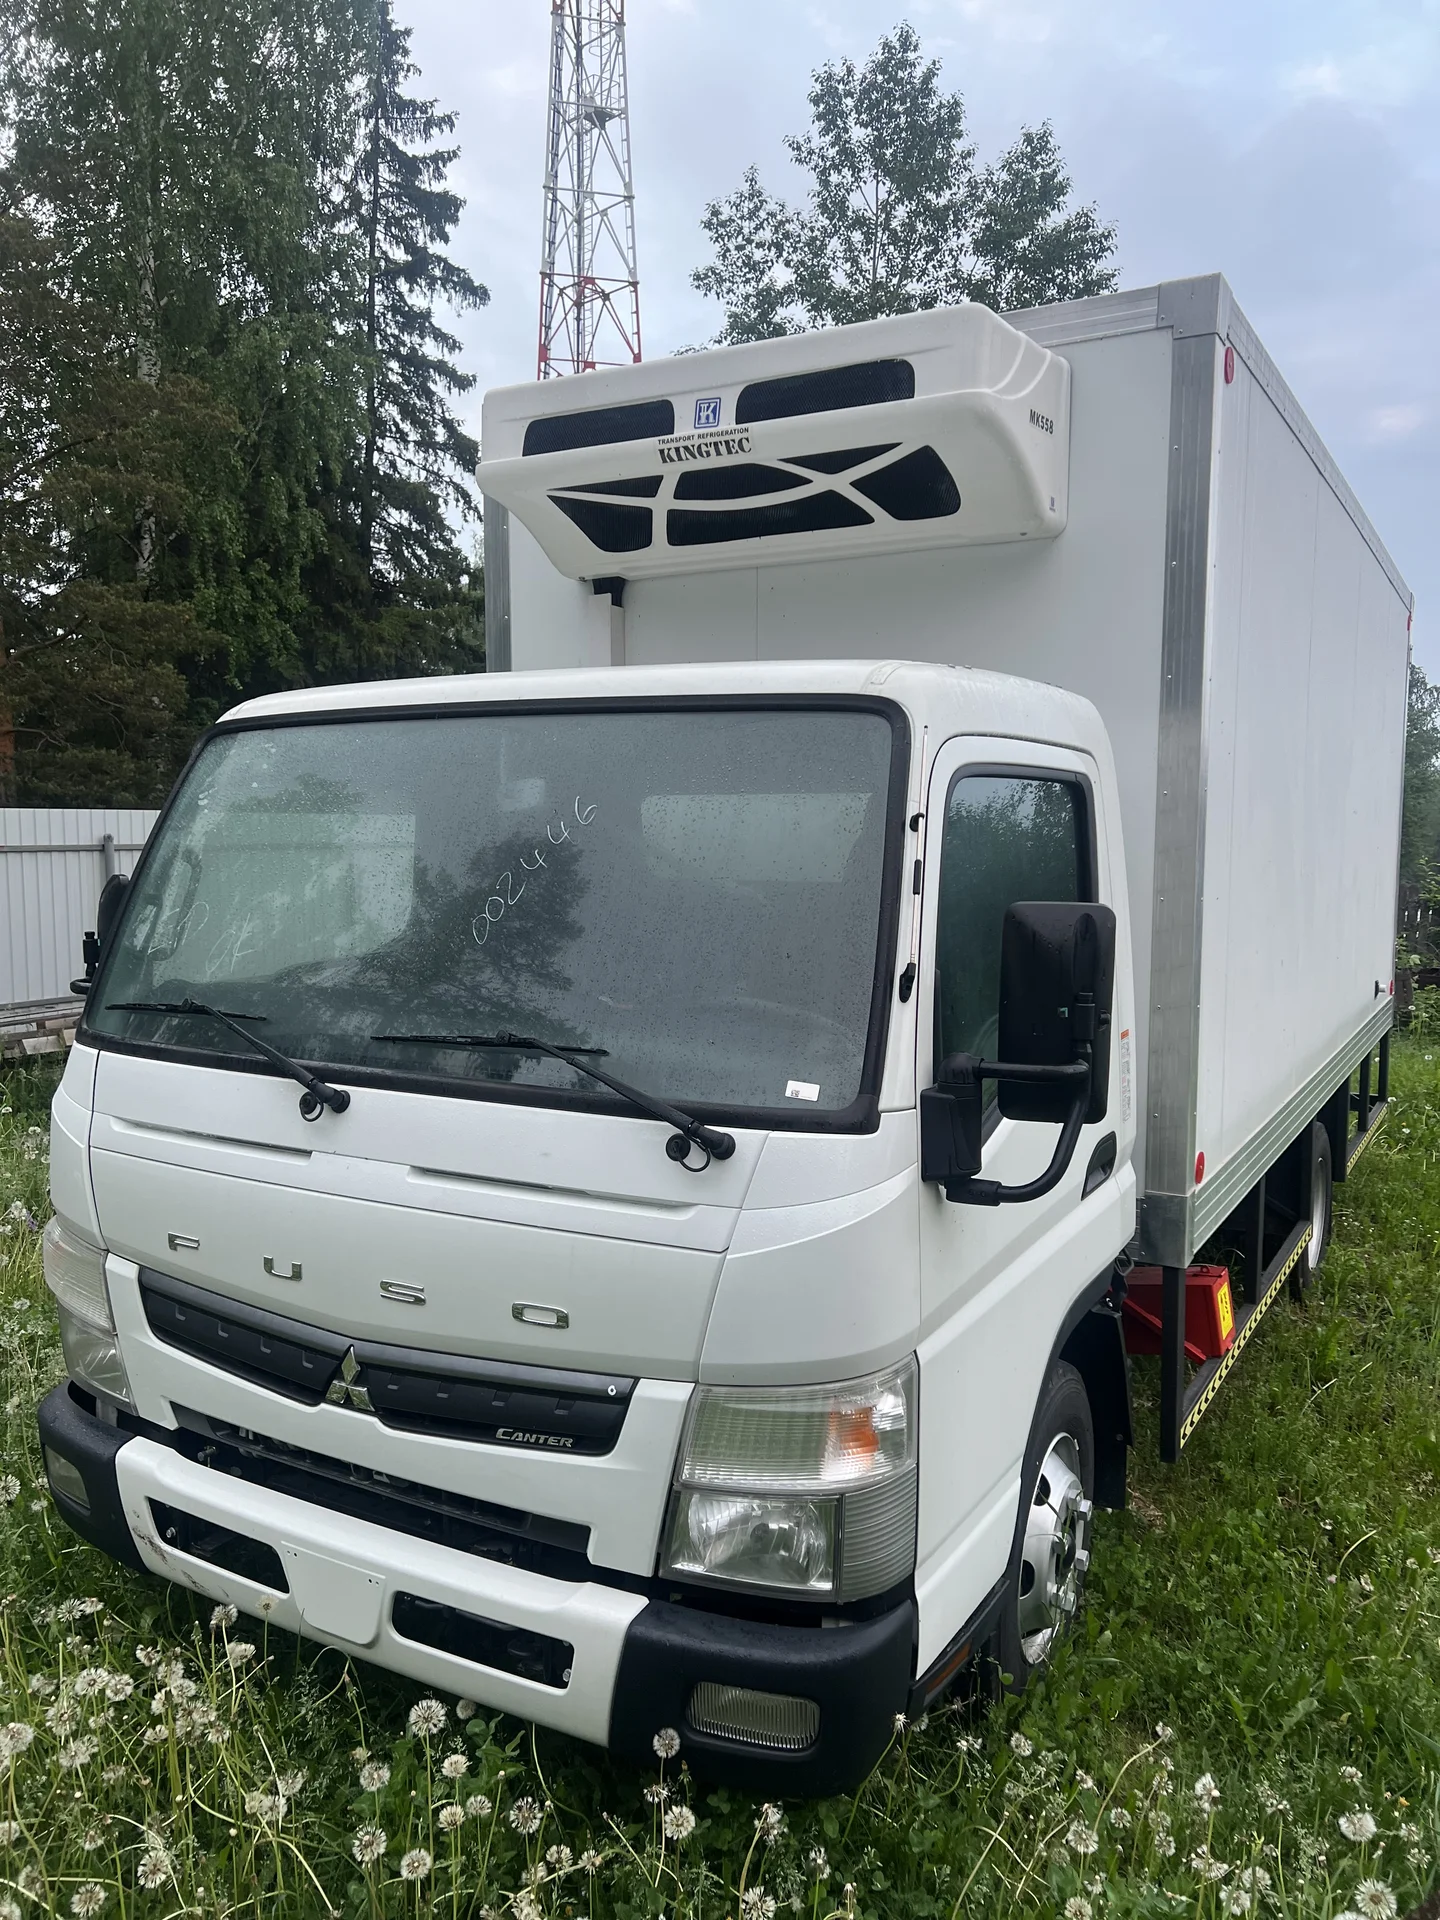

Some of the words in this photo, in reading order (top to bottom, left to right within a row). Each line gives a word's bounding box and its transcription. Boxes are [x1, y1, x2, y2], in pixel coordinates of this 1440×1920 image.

[1029, 408, 1054, 435] MK558
[657, 435, 696, 446] TRANSPORT
[697, 427, 750, 440] REFRIGERATION
[658, 436, 752, 464] KINGTEC
[472, 795, 598, 945] 002446
[167, 1231, 570, 1330] FUSO
[495, 1427, 574, 1448] CANTER
